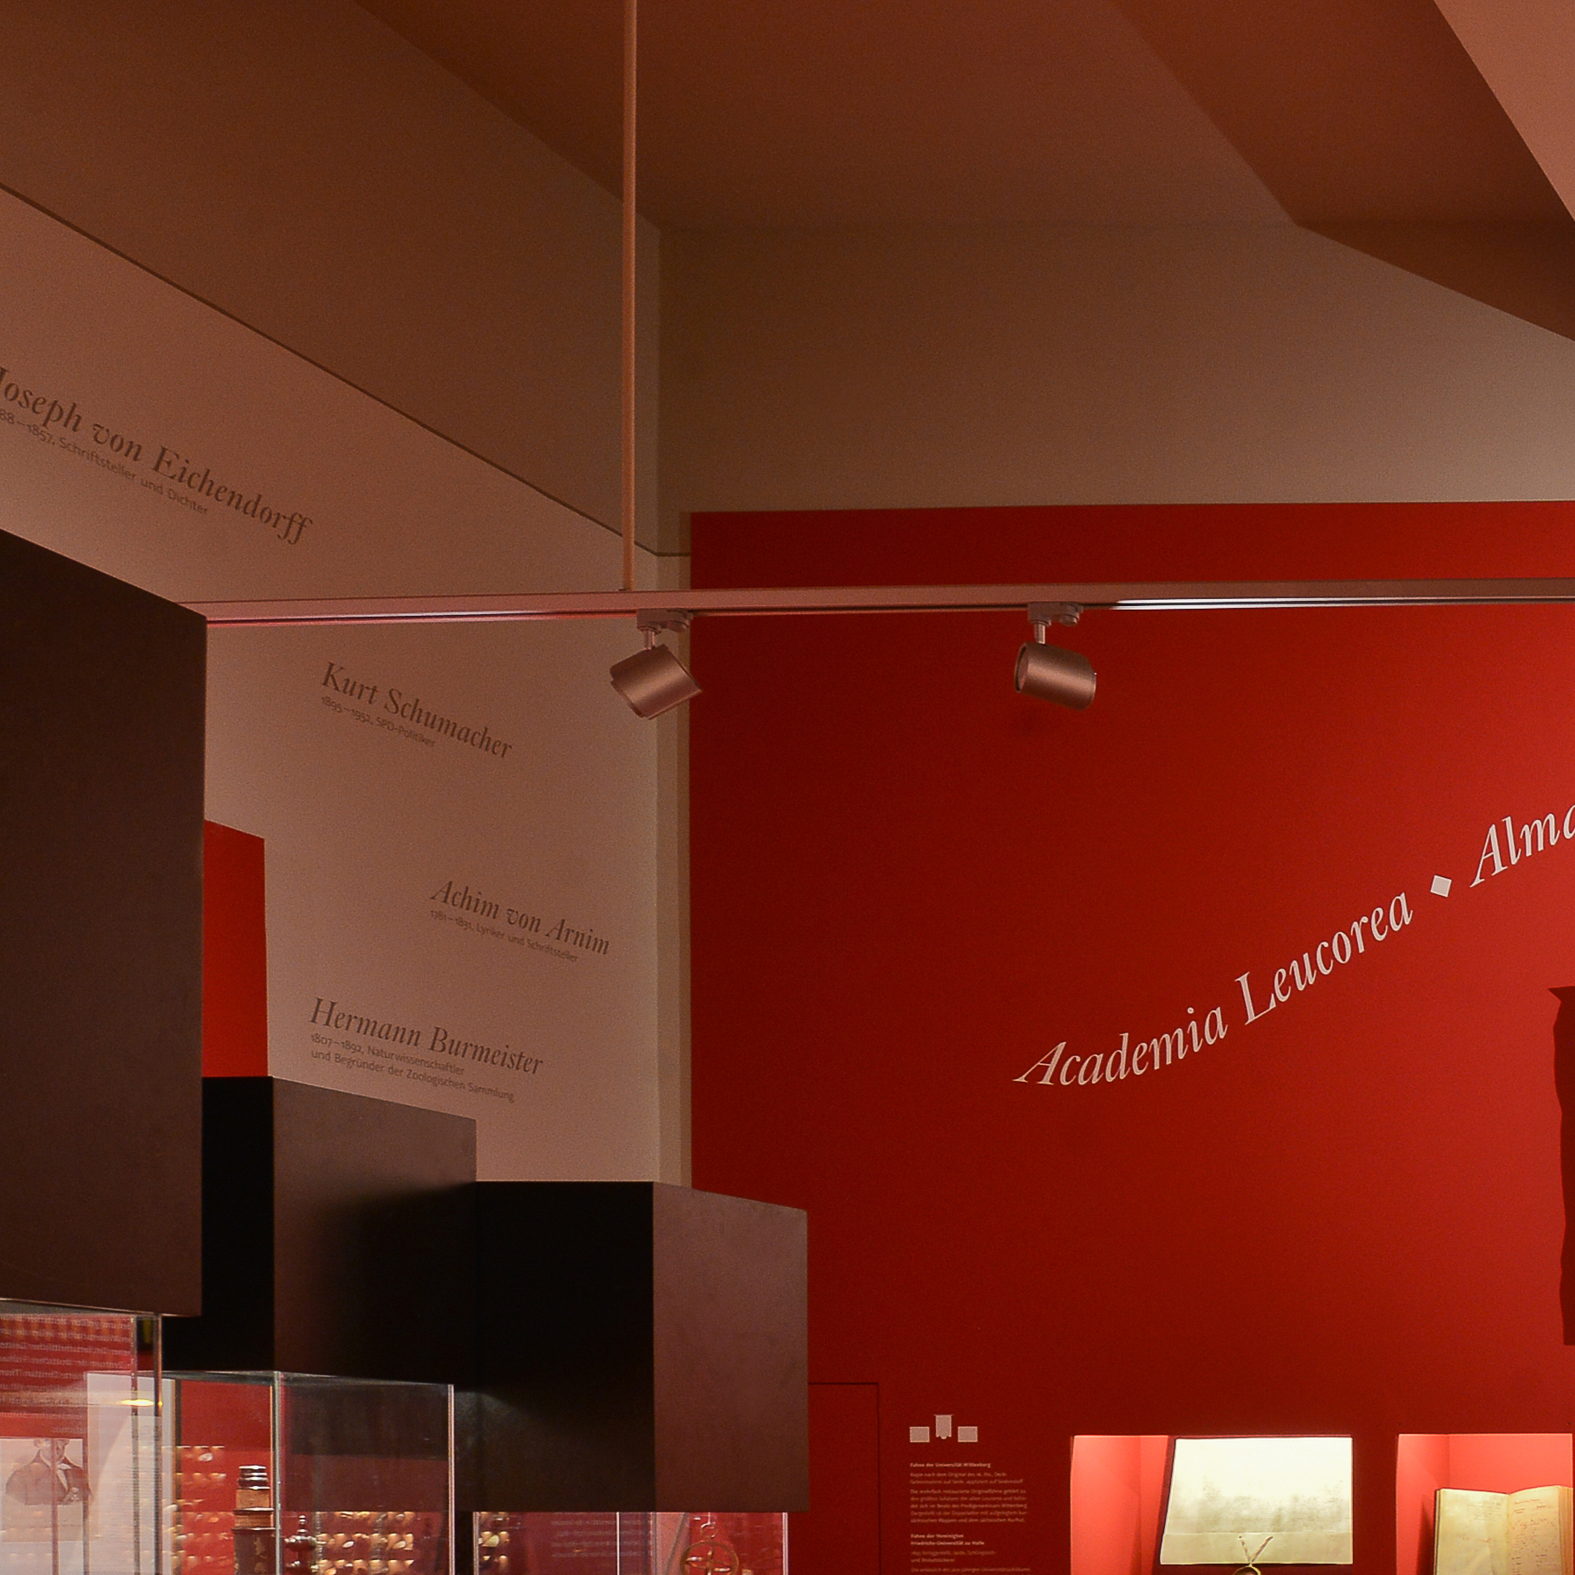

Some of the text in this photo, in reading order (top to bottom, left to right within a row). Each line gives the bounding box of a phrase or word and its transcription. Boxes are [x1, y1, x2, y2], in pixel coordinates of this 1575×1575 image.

[59, 437, 136, 481] Schriftsteller
[141, 475, 163, 495] und
[168, 489, 208, 514] Dichter
[91, 422, 143, 462] von
[150, 445, 314, 545] Eichendorff
[322, 661, 513, 758] Kurt Schumacher
[376, 716, 437, 748] SPD-Politiker
[430, 880, 610, 956] Achim von Arnim
[476, 923, 505, 939] Lyriker
[508, 935, 525, 946] und
[527, 938, 578, 963] Schriftsteller
[1012, 1006, 1228, 1086] Academia
[1235, 891, 1413, 1025] Leucorea
[309, 997, 544, 1075] Hermann Burmeister
[367, 1045, 465, 1076] Naturwissenschaftler
[311, 1050, 515, 1104] und Begründer der Zoologischen Sammlung
